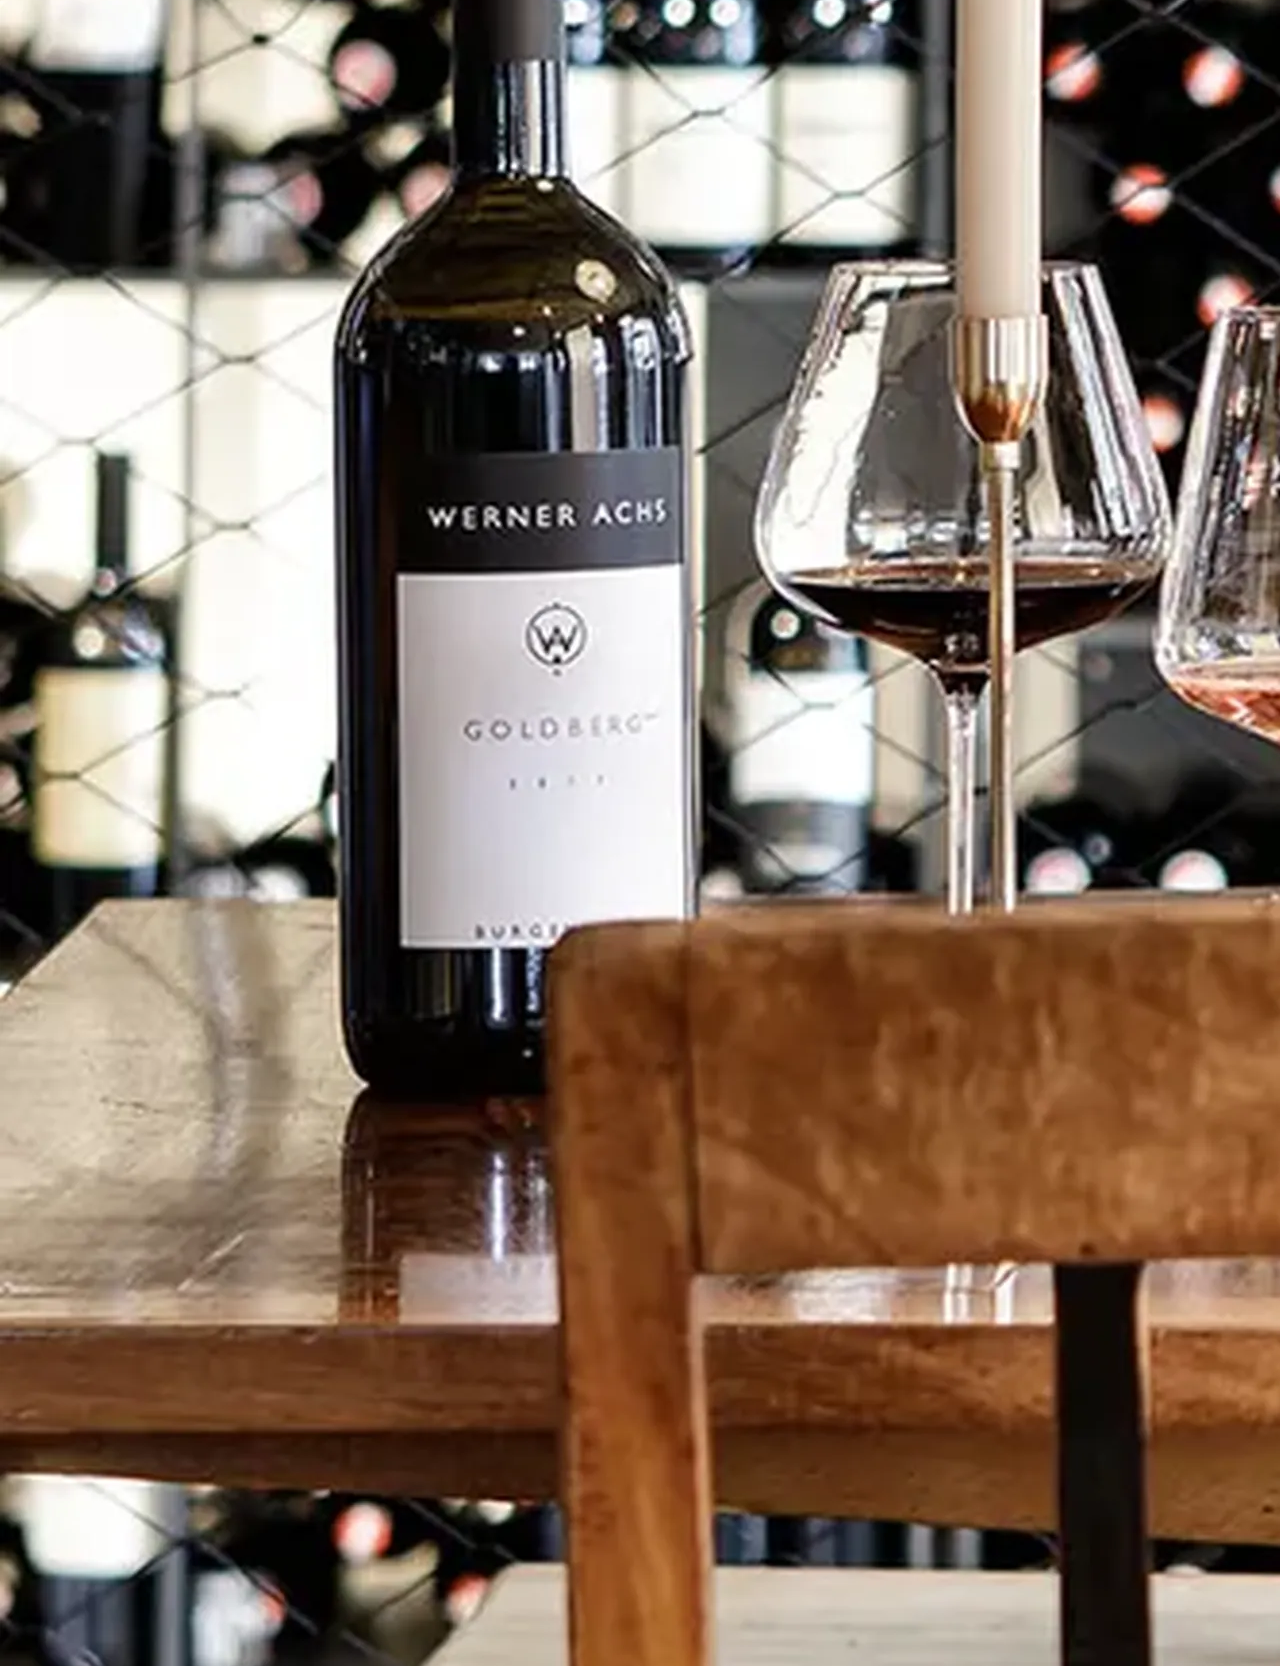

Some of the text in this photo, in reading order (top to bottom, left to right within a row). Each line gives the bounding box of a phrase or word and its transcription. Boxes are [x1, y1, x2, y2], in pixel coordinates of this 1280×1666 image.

[427, 497, 668, 530] WERNER ACHS
[463, 713, 643, 742] GOLDBERG
